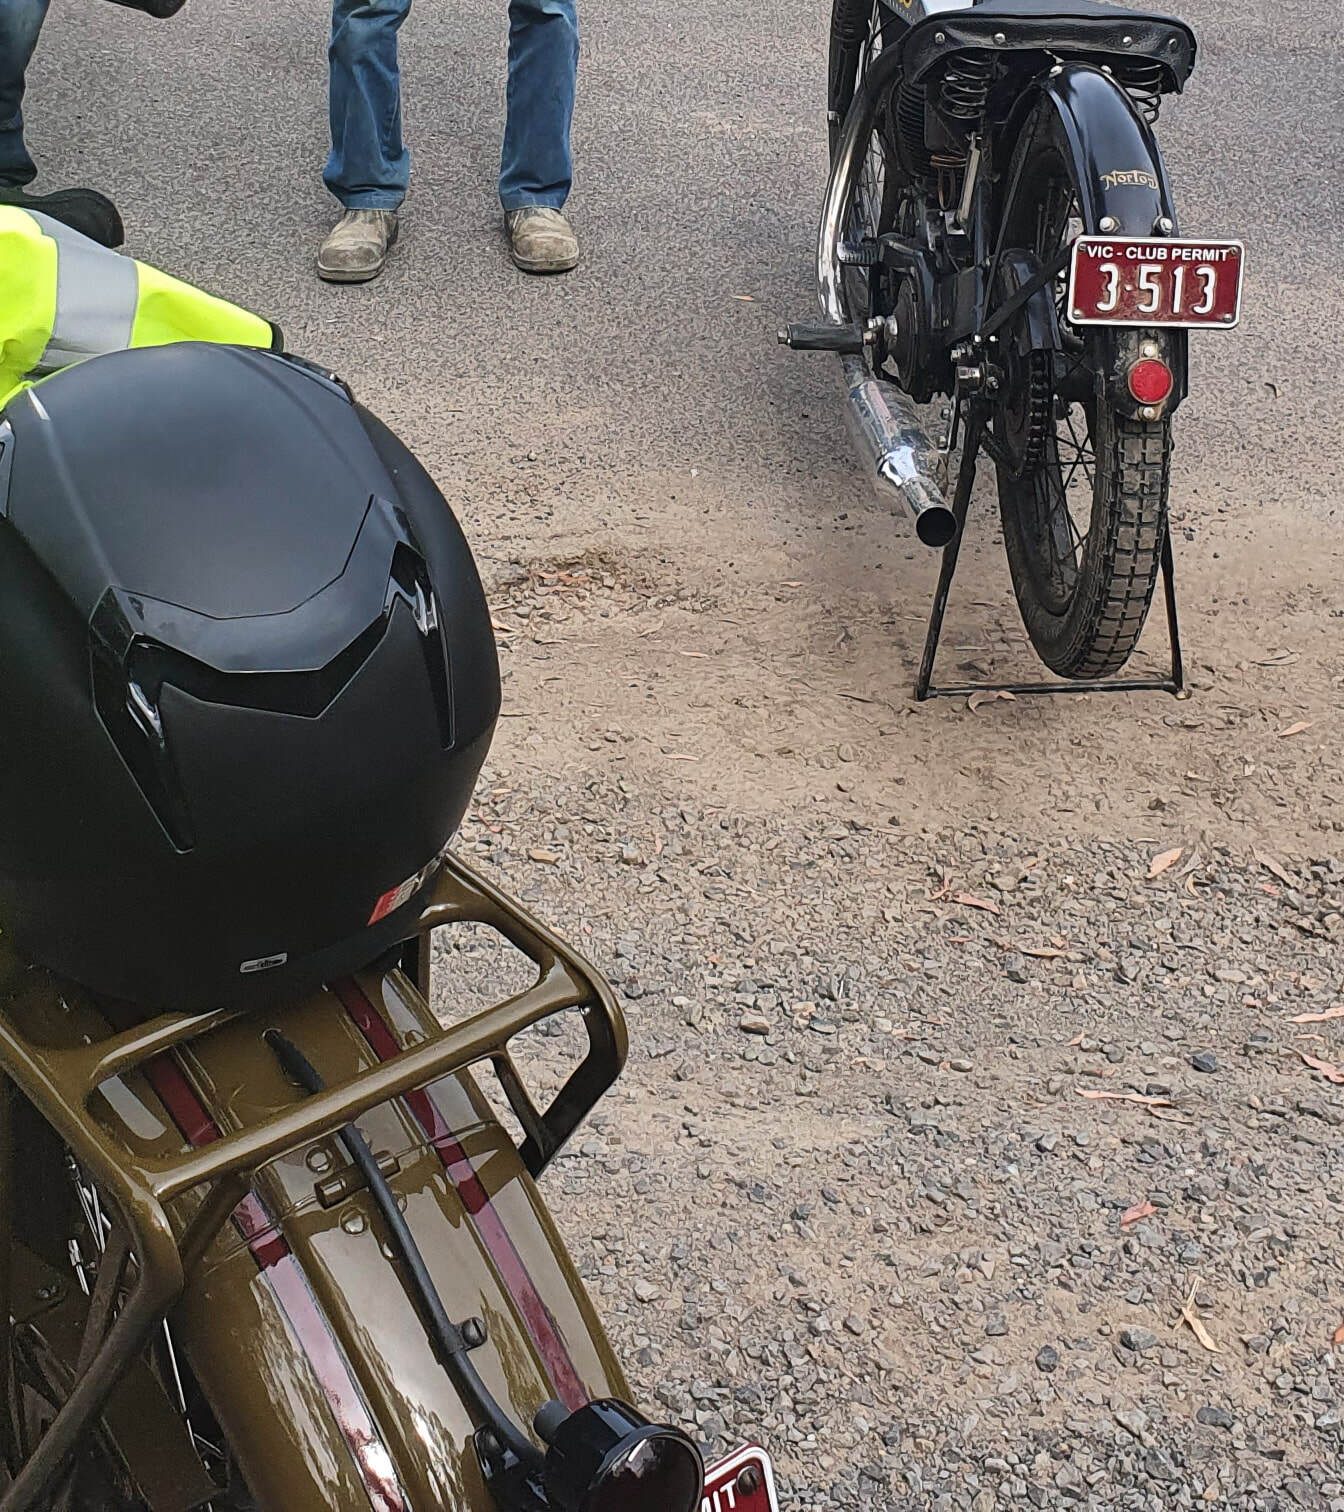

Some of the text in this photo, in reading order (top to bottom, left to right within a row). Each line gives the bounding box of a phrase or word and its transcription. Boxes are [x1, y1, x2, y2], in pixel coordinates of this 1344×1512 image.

[1099, 169, 1158, 191] Norton
[1086, 245, 1114, 259] VIC
[1125, 246, 1168, 261] CLUB
[1171, 248, 1229, 263] PERMIT
